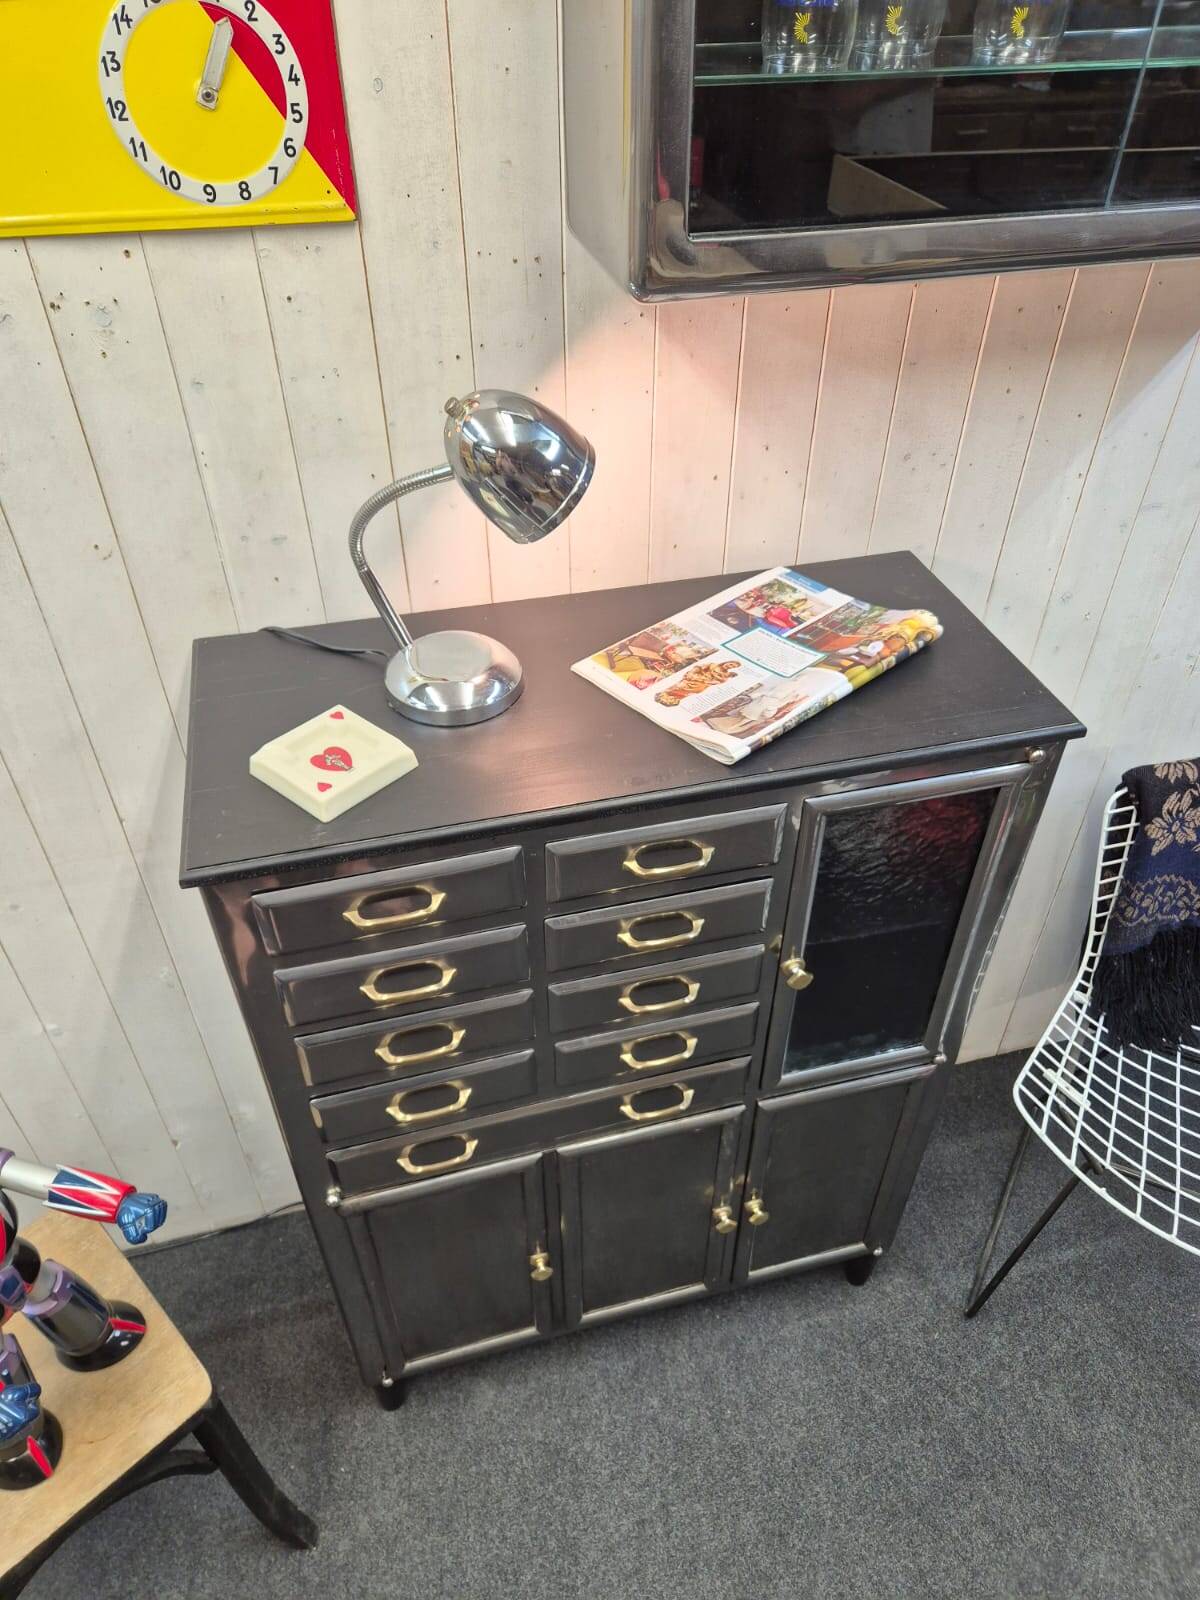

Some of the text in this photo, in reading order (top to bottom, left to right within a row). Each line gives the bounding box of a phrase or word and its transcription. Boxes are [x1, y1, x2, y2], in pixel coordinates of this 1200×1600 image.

[112, 4, 133, 36] 14
[244, 0, 259, 22] 2
[272, 33, 286, 55] 3
[101, 50, 121, 77] 13
[287, 63, 301, 87] 4
[106, 97, 129, 122] 12
[290, 102, 304, 124] 5
[128, 136, 148, 162] 11
[283, 137, 297, 158] 6
[159, 165, 182, 191] 10
[268, 166, 279, 185] 7
[202, 183, 217, 203] 9
[238, 180, 252, 201] 8
